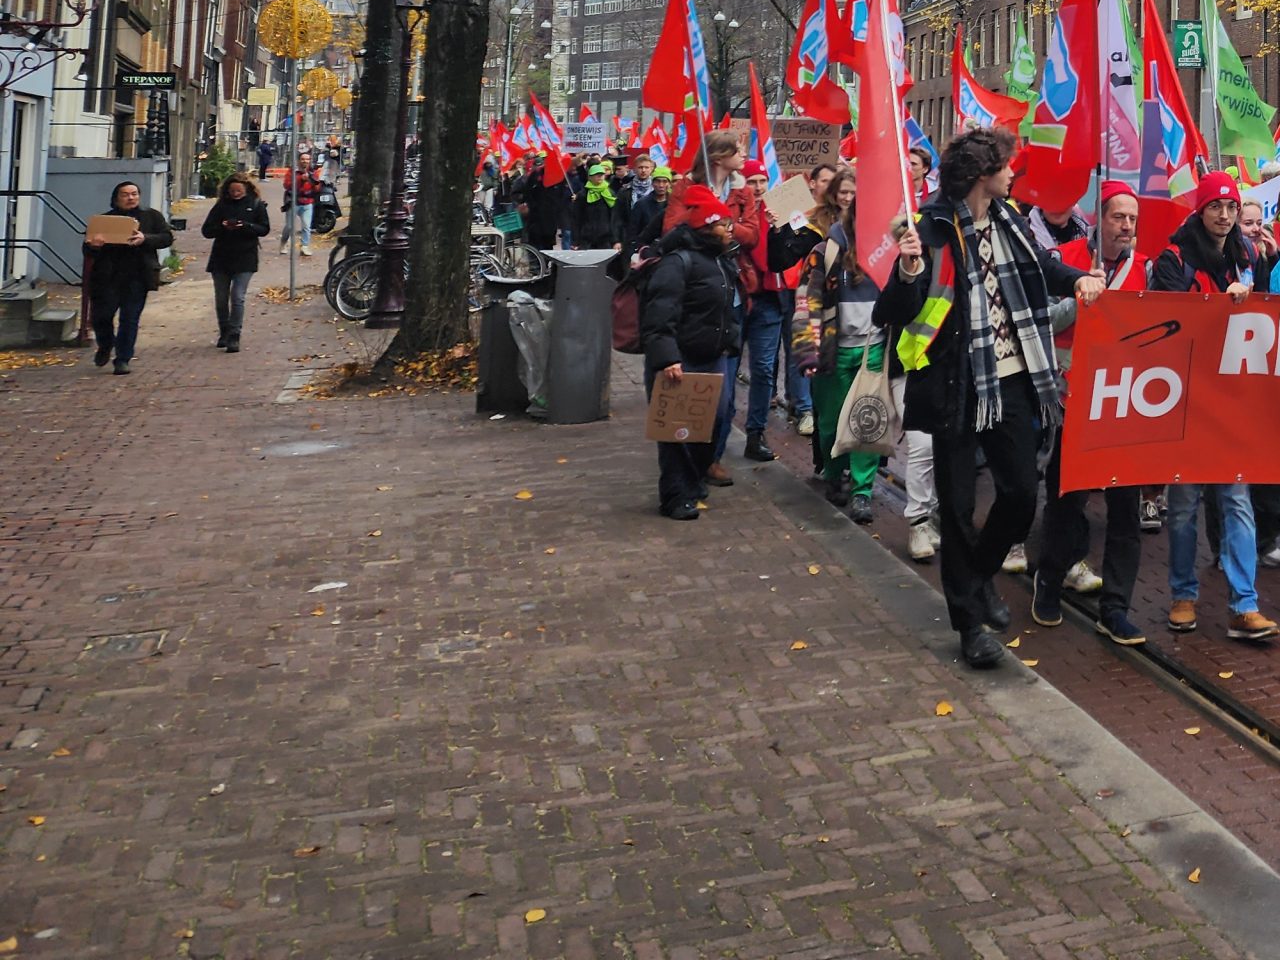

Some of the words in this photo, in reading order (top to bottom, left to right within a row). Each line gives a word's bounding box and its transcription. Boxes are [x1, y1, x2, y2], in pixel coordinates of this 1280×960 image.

[122, 76, 173, 84] STEPANOF
[819, 141, 830, 154] IS
[678, 381, 714, 432] STOP
[1089, 366, 1183, 420] HO
